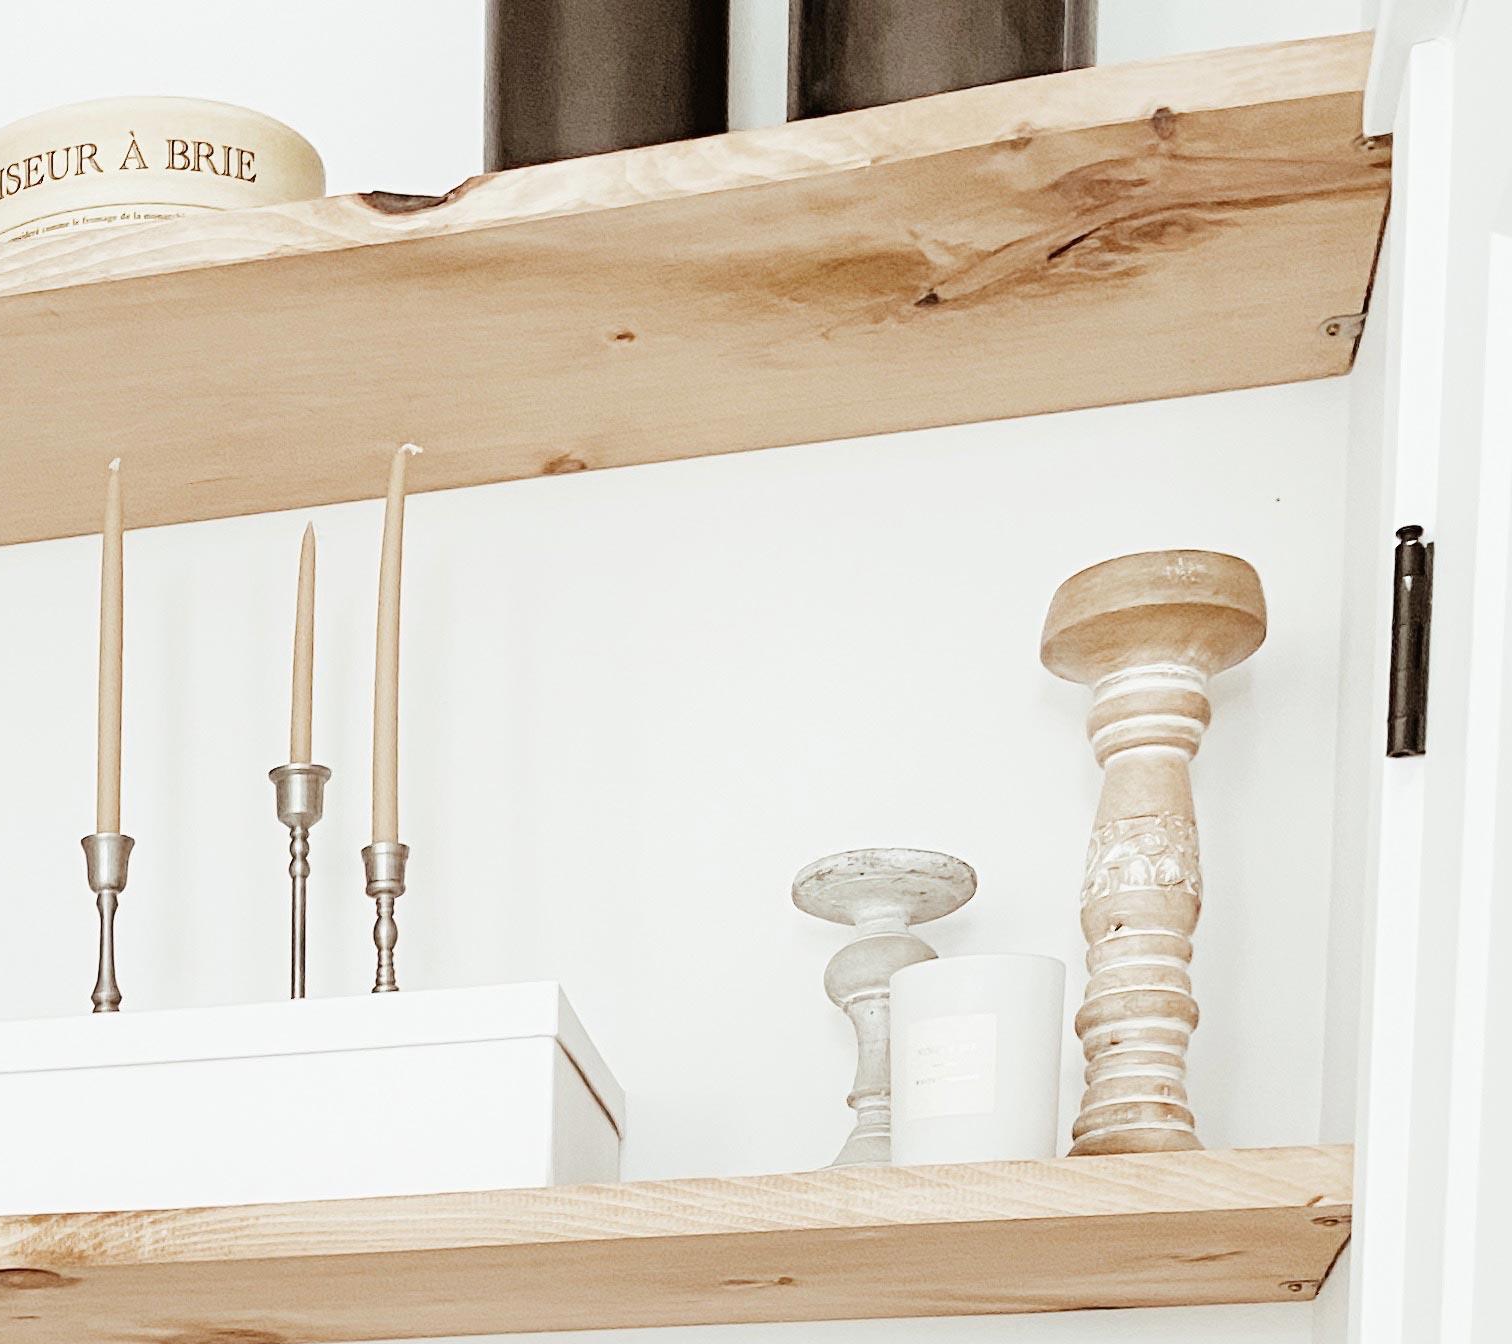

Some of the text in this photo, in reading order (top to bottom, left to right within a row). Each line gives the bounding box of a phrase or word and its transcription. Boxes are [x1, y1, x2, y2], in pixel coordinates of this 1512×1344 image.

[119, 130, 148, 170] À
[165, 139, 257, 183] BRIE
[120, 212, 132, 221] de
[133, 211, 141, 220] la
